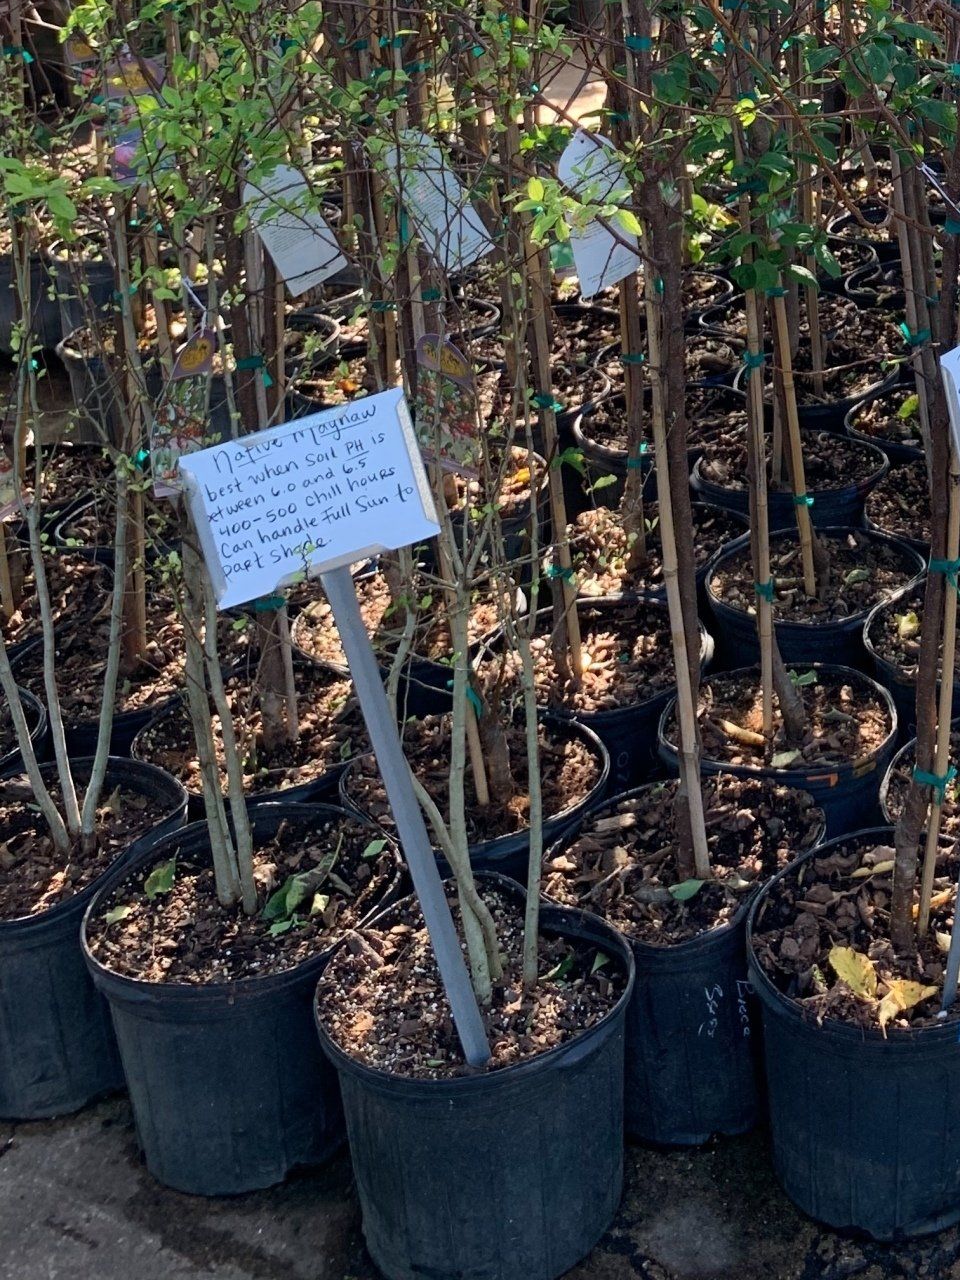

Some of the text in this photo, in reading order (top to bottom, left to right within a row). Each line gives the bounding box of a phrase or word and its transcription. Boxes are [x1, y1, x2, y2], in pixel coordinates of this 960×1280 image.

[204, 477, 243, 503] best
[248, 460, 300, 485] when
[344, 438, 365, 455] PH
[371, 431, 386, 445] is
[219, 502, 298, 537] 400-500
[346, 466, 396, 493] hours
[270, 482, 297, 498] 6.0
[302, 467, 336, 488] and
[342, 457, 368, 475] 6.5
[221, 539, 254, 559] Can
[257, 516, 319, 544] handle
[394, 483, 414, 503] to
[222, 551, 265, 583] part
